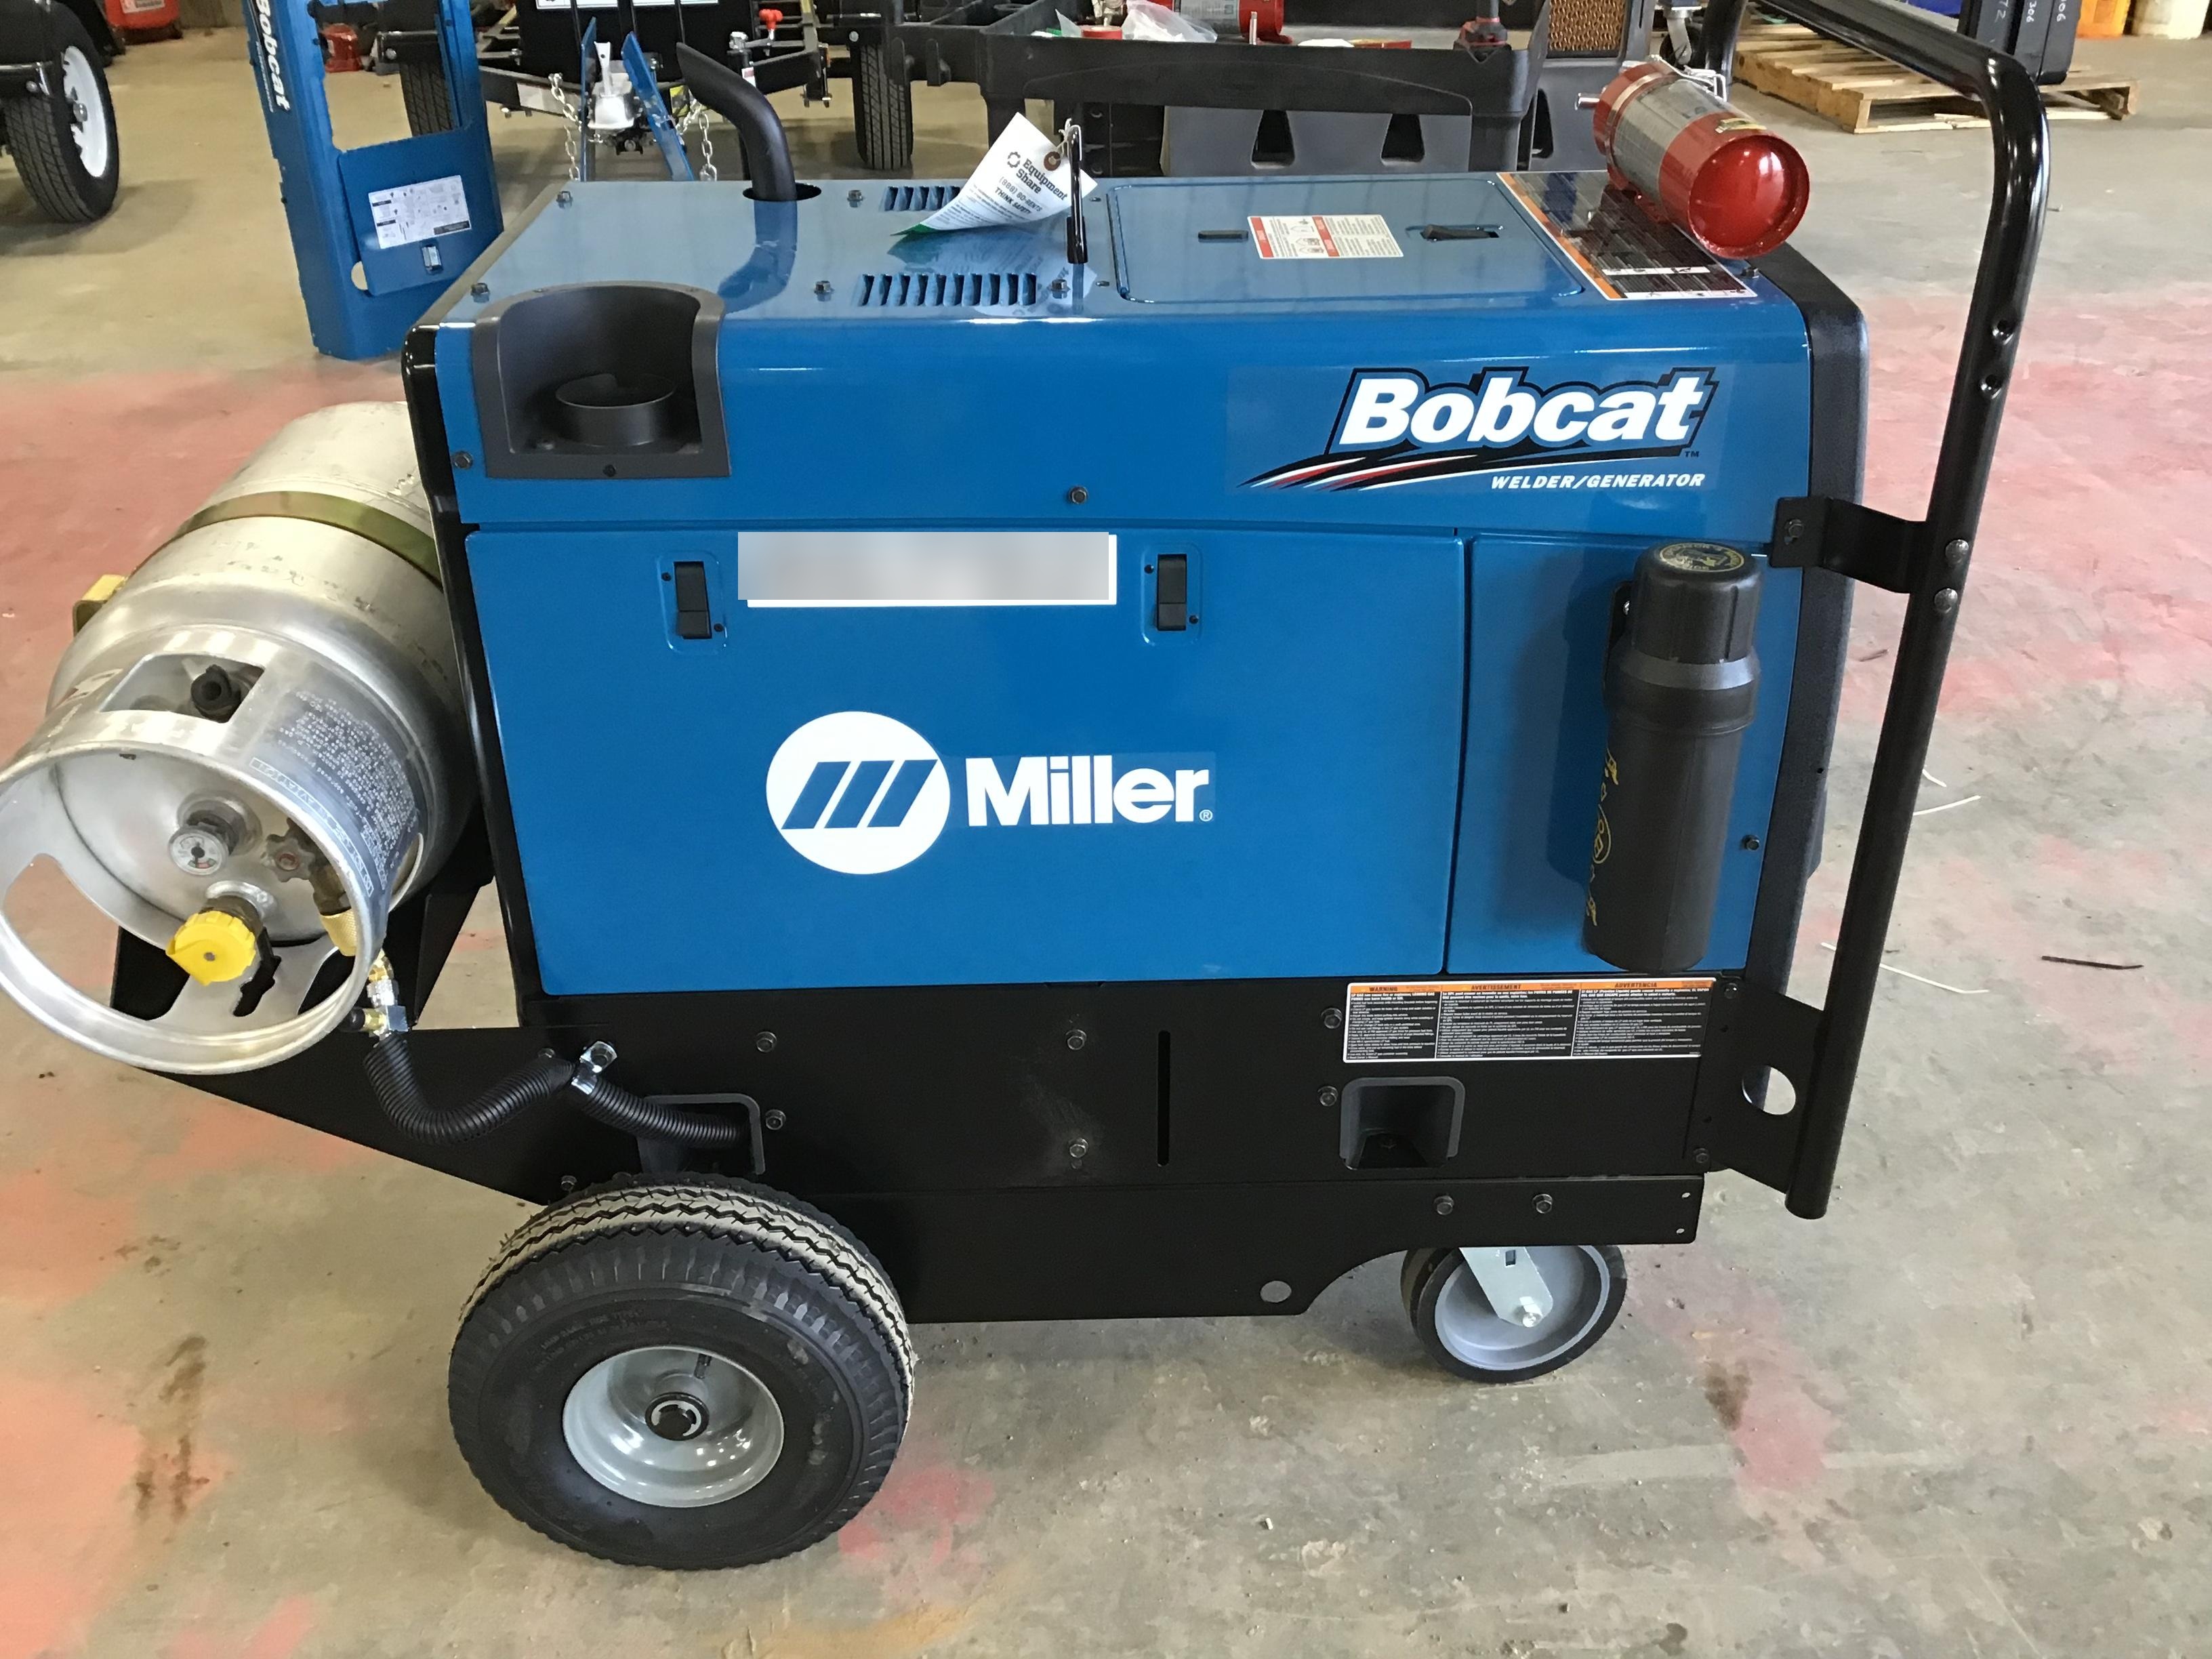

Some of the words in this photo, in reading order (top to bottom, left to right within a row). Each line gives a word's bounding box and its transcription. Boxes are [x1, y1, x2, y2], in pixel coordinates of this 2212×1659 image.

[255, 0, 291, 110] Bobcat
[995, 187, 1012, 205] THINK
[1016, 168, 1042, 194] Share
[1023, 158, 1068, 201] Equipment
[1338, 376, 1704, 445] Bobcat
[1491, 473, 1706, 489] WELDER/GENERATOR
[965, 754, 1209, 827] Miller
